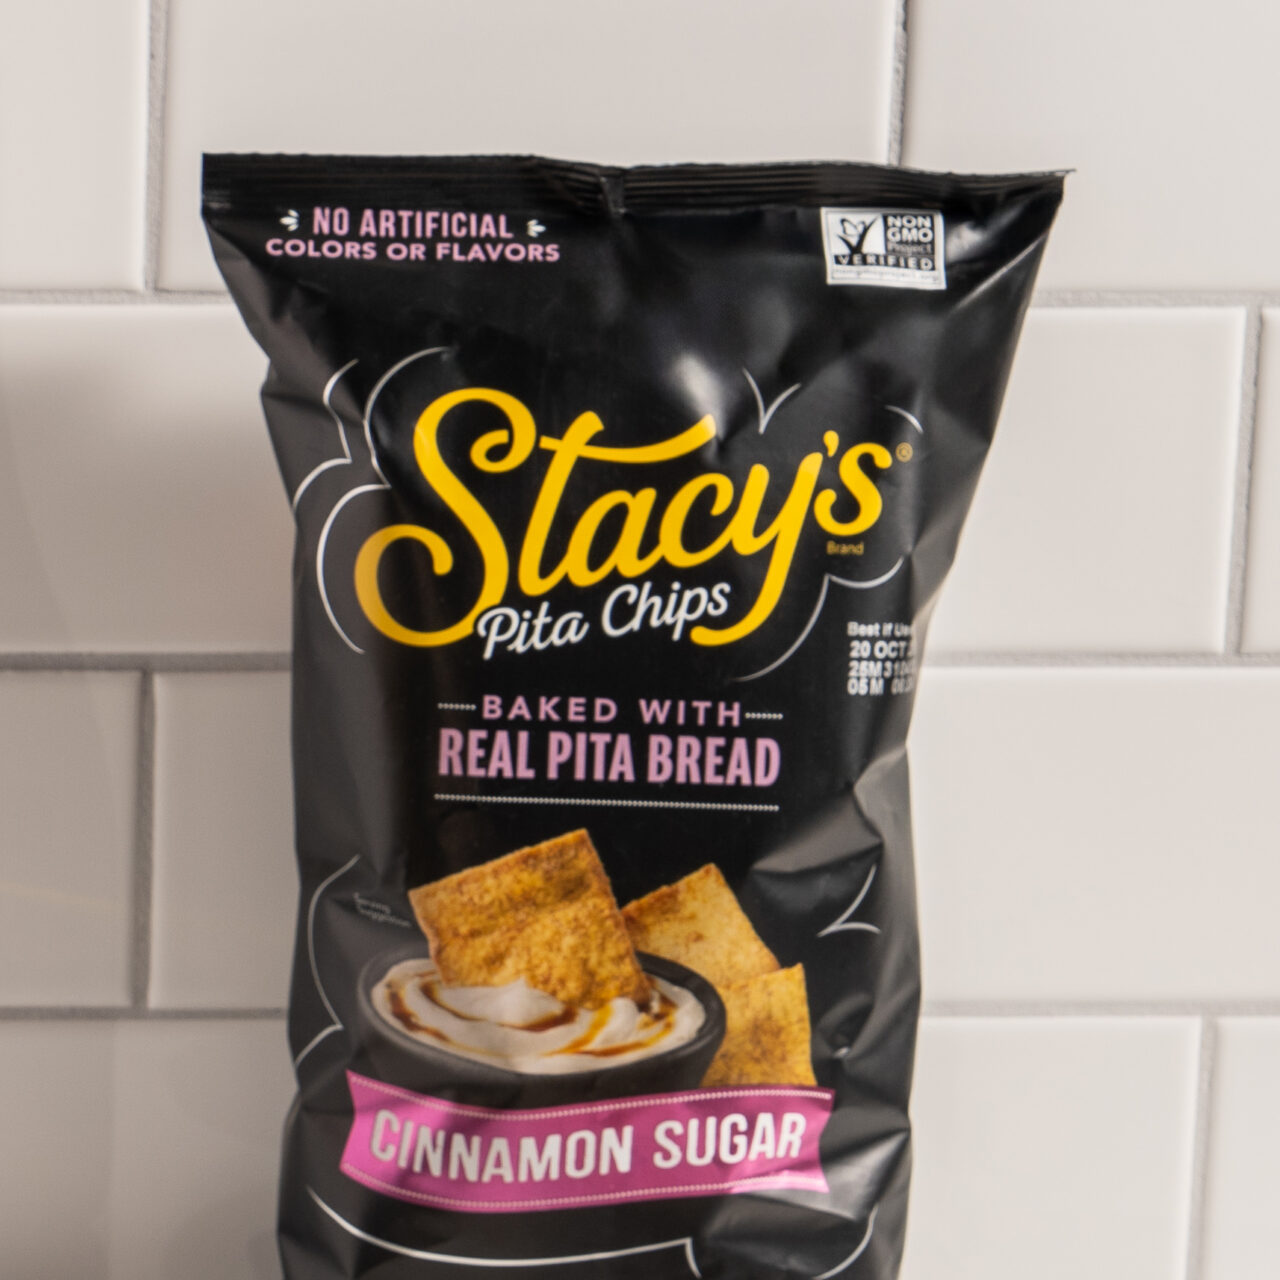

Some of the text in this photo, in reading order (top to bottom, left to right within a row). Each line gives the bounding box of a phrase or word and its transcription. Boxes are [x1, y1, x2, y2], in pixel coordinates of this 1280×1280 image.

[312, 206, 515, 240] NO ARTIFICIAL
[886, 215, 932, 228] NON
[886, 226, 934, 243] GMO
[265, 237, 561, 263] COLORS OR FLAVORS
[836, 255, 934, 271] VERIFIED
[354, 387, 893, 647] Stacy's
[825, 540, 865, 556] Brand
[477, 581, 732, 660] Pita Chips
[846, 621, 880, 637] Best
[848, 640, 871, 659] 20
[873, 640, 907, 659] OCT
[481, 695, 741, 727] BAKED WITH
[438, 728, 781, 787] REAL PITA BREAD
[369, 1108, 807, 1184] CINNAMON SUGAR
